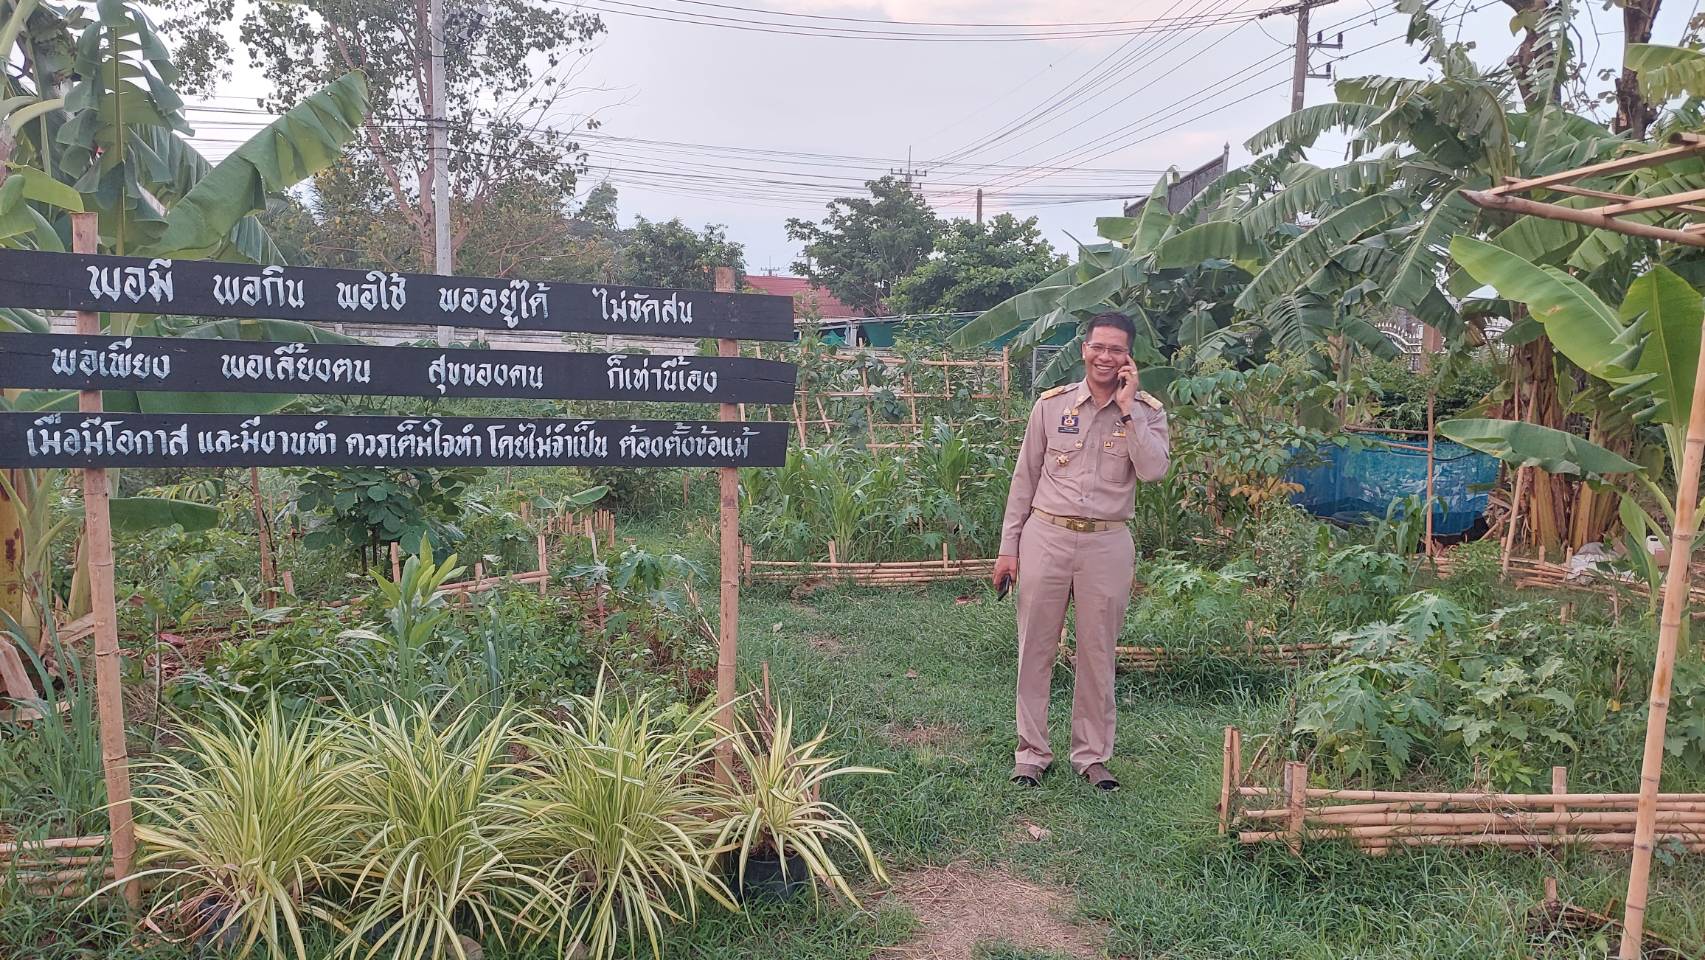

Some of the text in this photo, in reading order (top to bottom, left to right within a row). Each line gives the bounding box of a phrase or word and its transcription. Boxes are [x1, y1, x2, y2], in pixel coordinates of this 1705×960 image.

[86, 258, 693, 330] พอมี พอกิน พอใช้ พออยู่ได้ ไม่ขัดสน
[51, 337, 718, 395] พอเพียง พอเลี้ยงตน สุขของคน ก็เท่านี้เอง
[26, 413, 761, 460] เมื่อมีโอกาส และมีงานทำ ควรเต็มใจทำ โดยไม่จำเป็น ต้องตั้งข้อแม้
